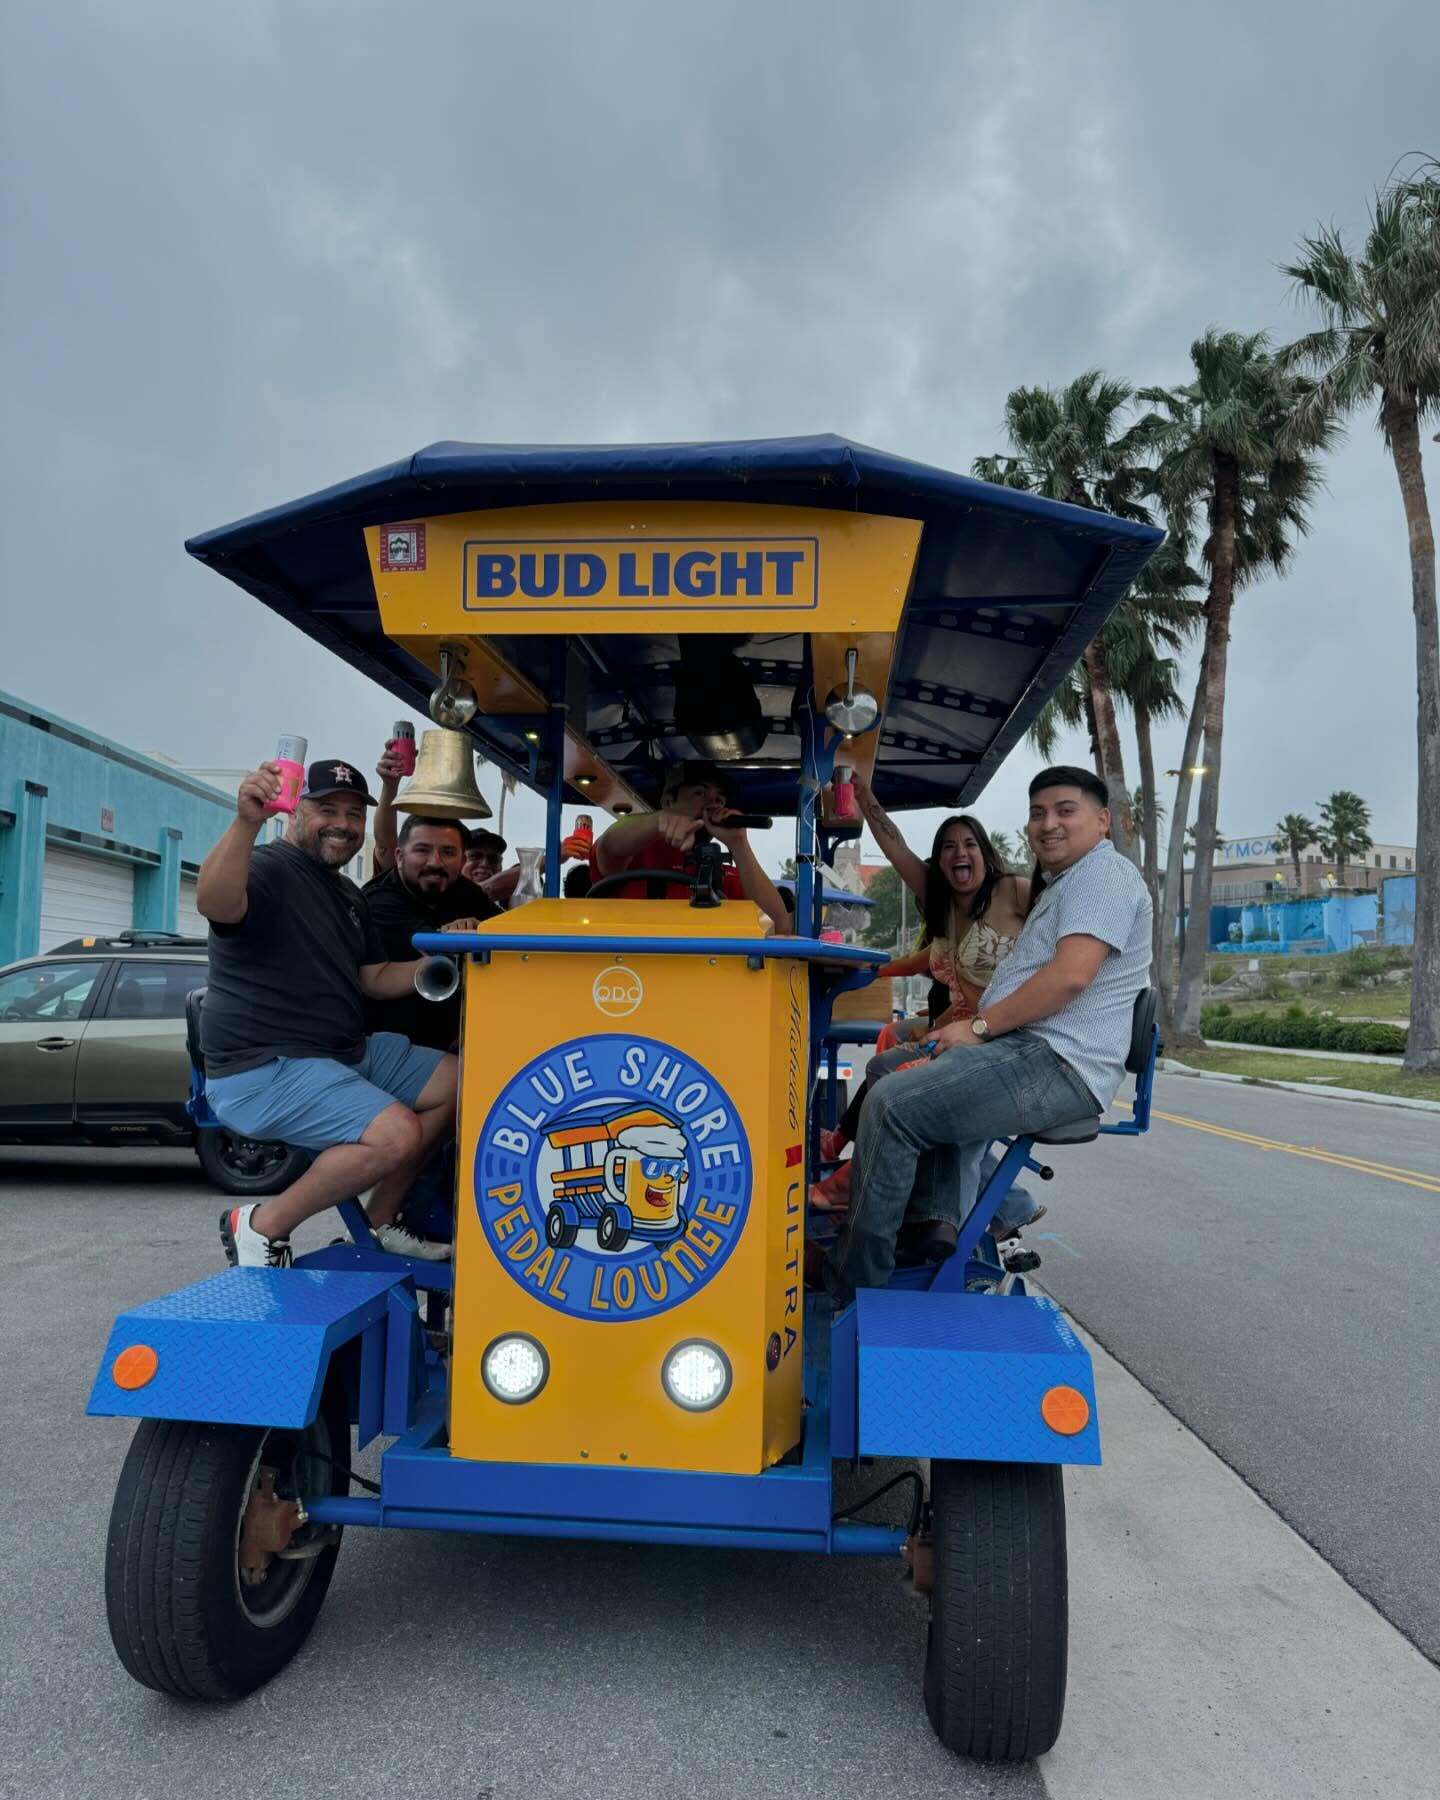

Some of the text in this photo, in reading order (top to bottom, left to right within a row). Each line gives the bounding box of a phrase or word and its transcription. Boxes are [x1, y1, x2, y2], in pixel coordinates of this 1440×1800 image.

[476, 551, 805, 598] BUD LIGHT
[1222, 840, 1276, 858] YMCA
[492, 1047, 741, 1170] BLUE SHORE
[487, 1182, 571, 1301] PEDAL
[784, 1182, 799, 1359] ULTRA
